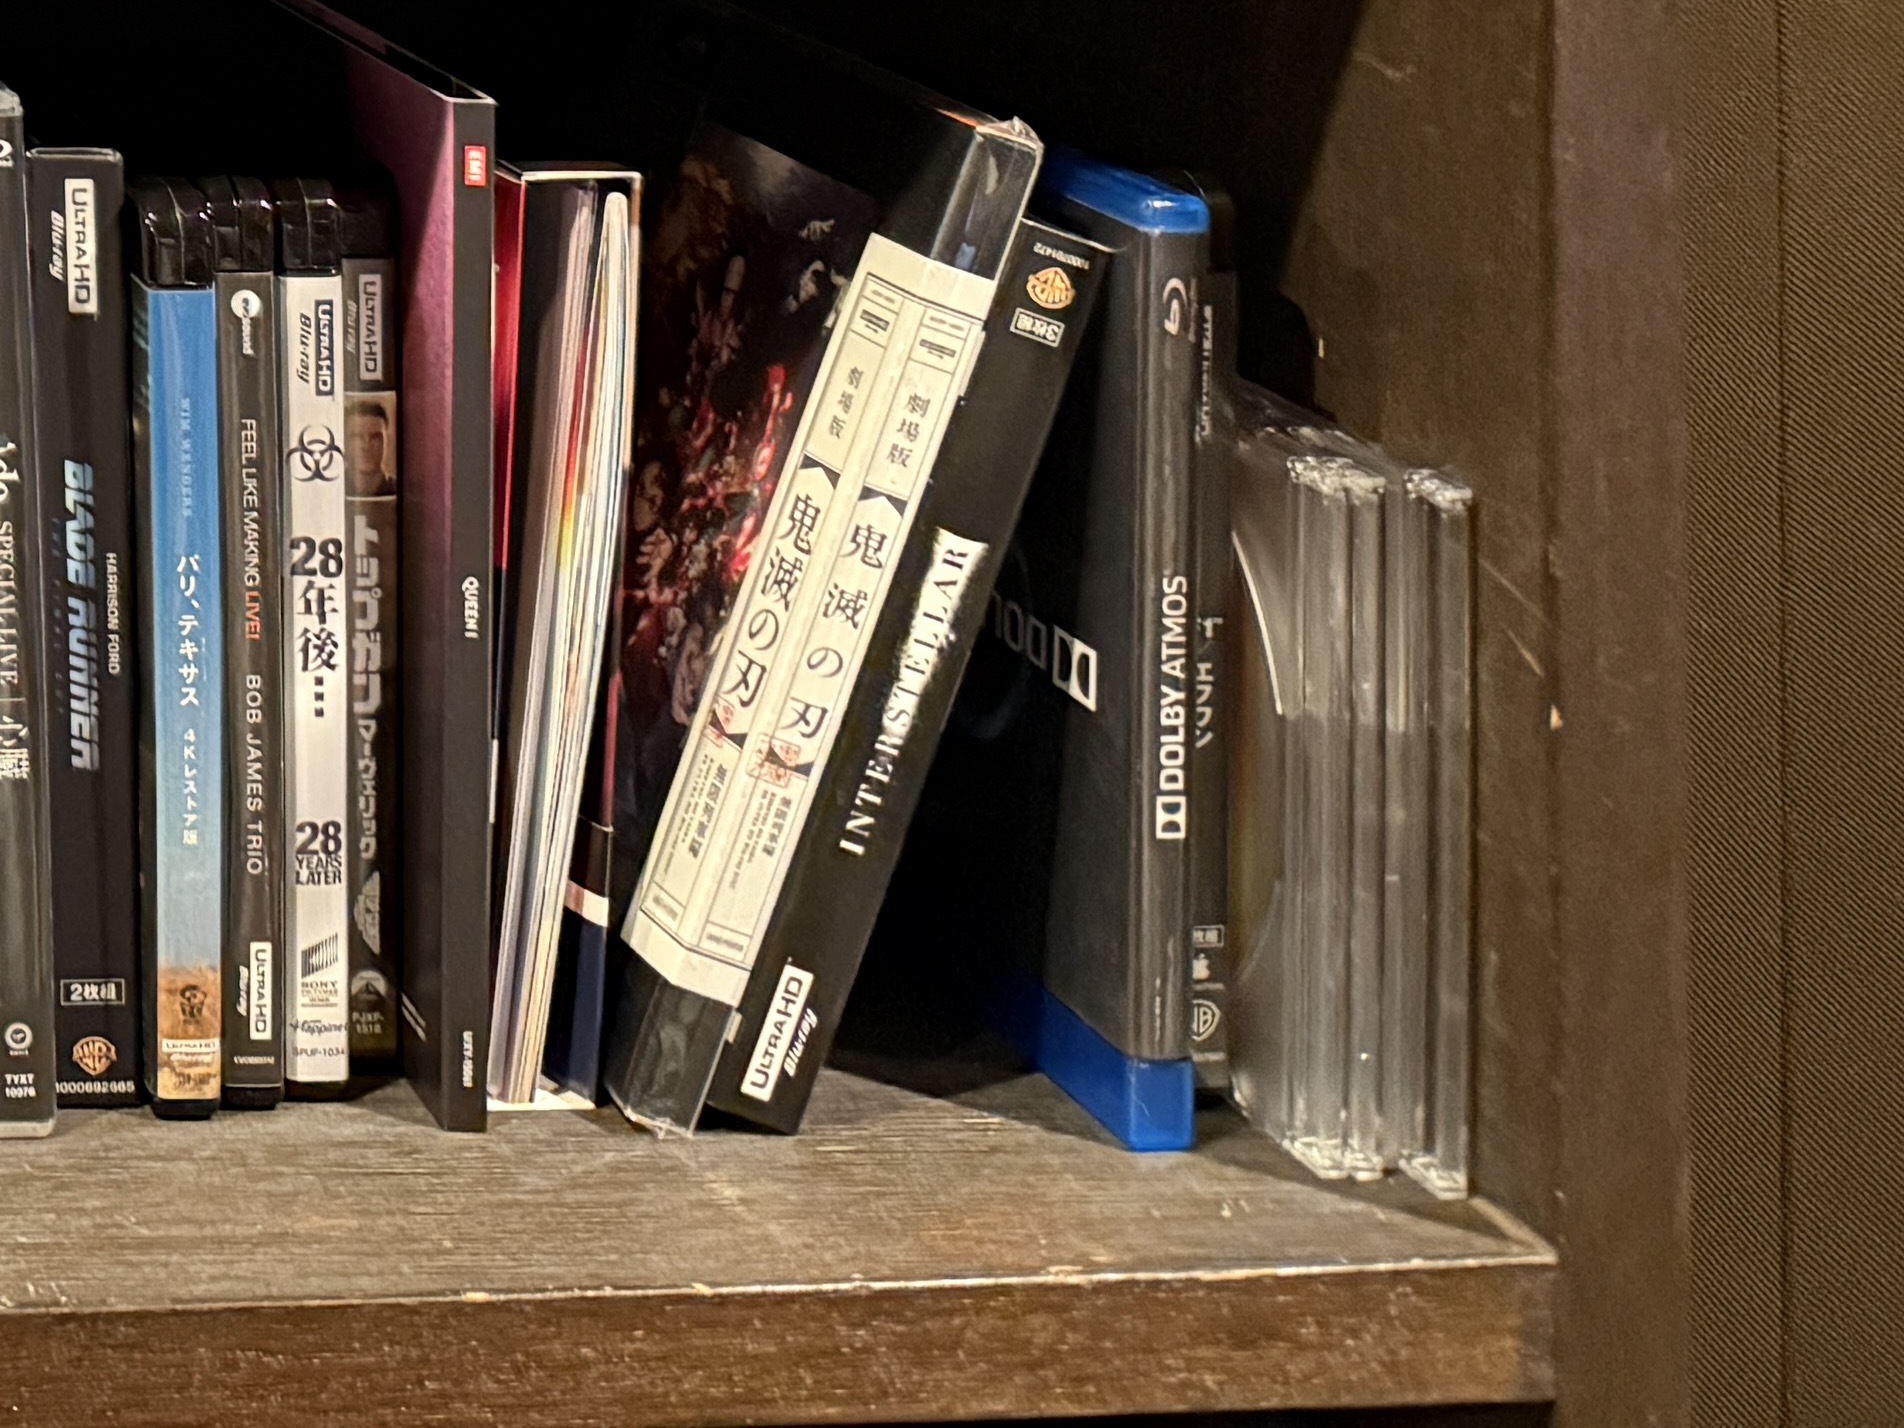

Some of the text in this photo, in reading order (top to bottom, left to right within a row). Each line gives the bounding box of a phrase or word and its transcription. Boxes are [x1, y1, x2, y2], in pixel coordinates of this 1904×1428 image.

[240, 417, 258, 466] FEEL
[242, 466, 259, 509] LIKE
[244, 510, 262, 586] MAKING
[780, 523, 888, 740] 鬼滅の刃
[1158, 575, 1190, 792] DOLBY ATMOS
[245, 674, 266, 877] BOB JAMES TRIO
[295, 820, 344, 856] 28
[295, 855, 344, 871] YEARS
[295, 871, 344, 887] LATER
